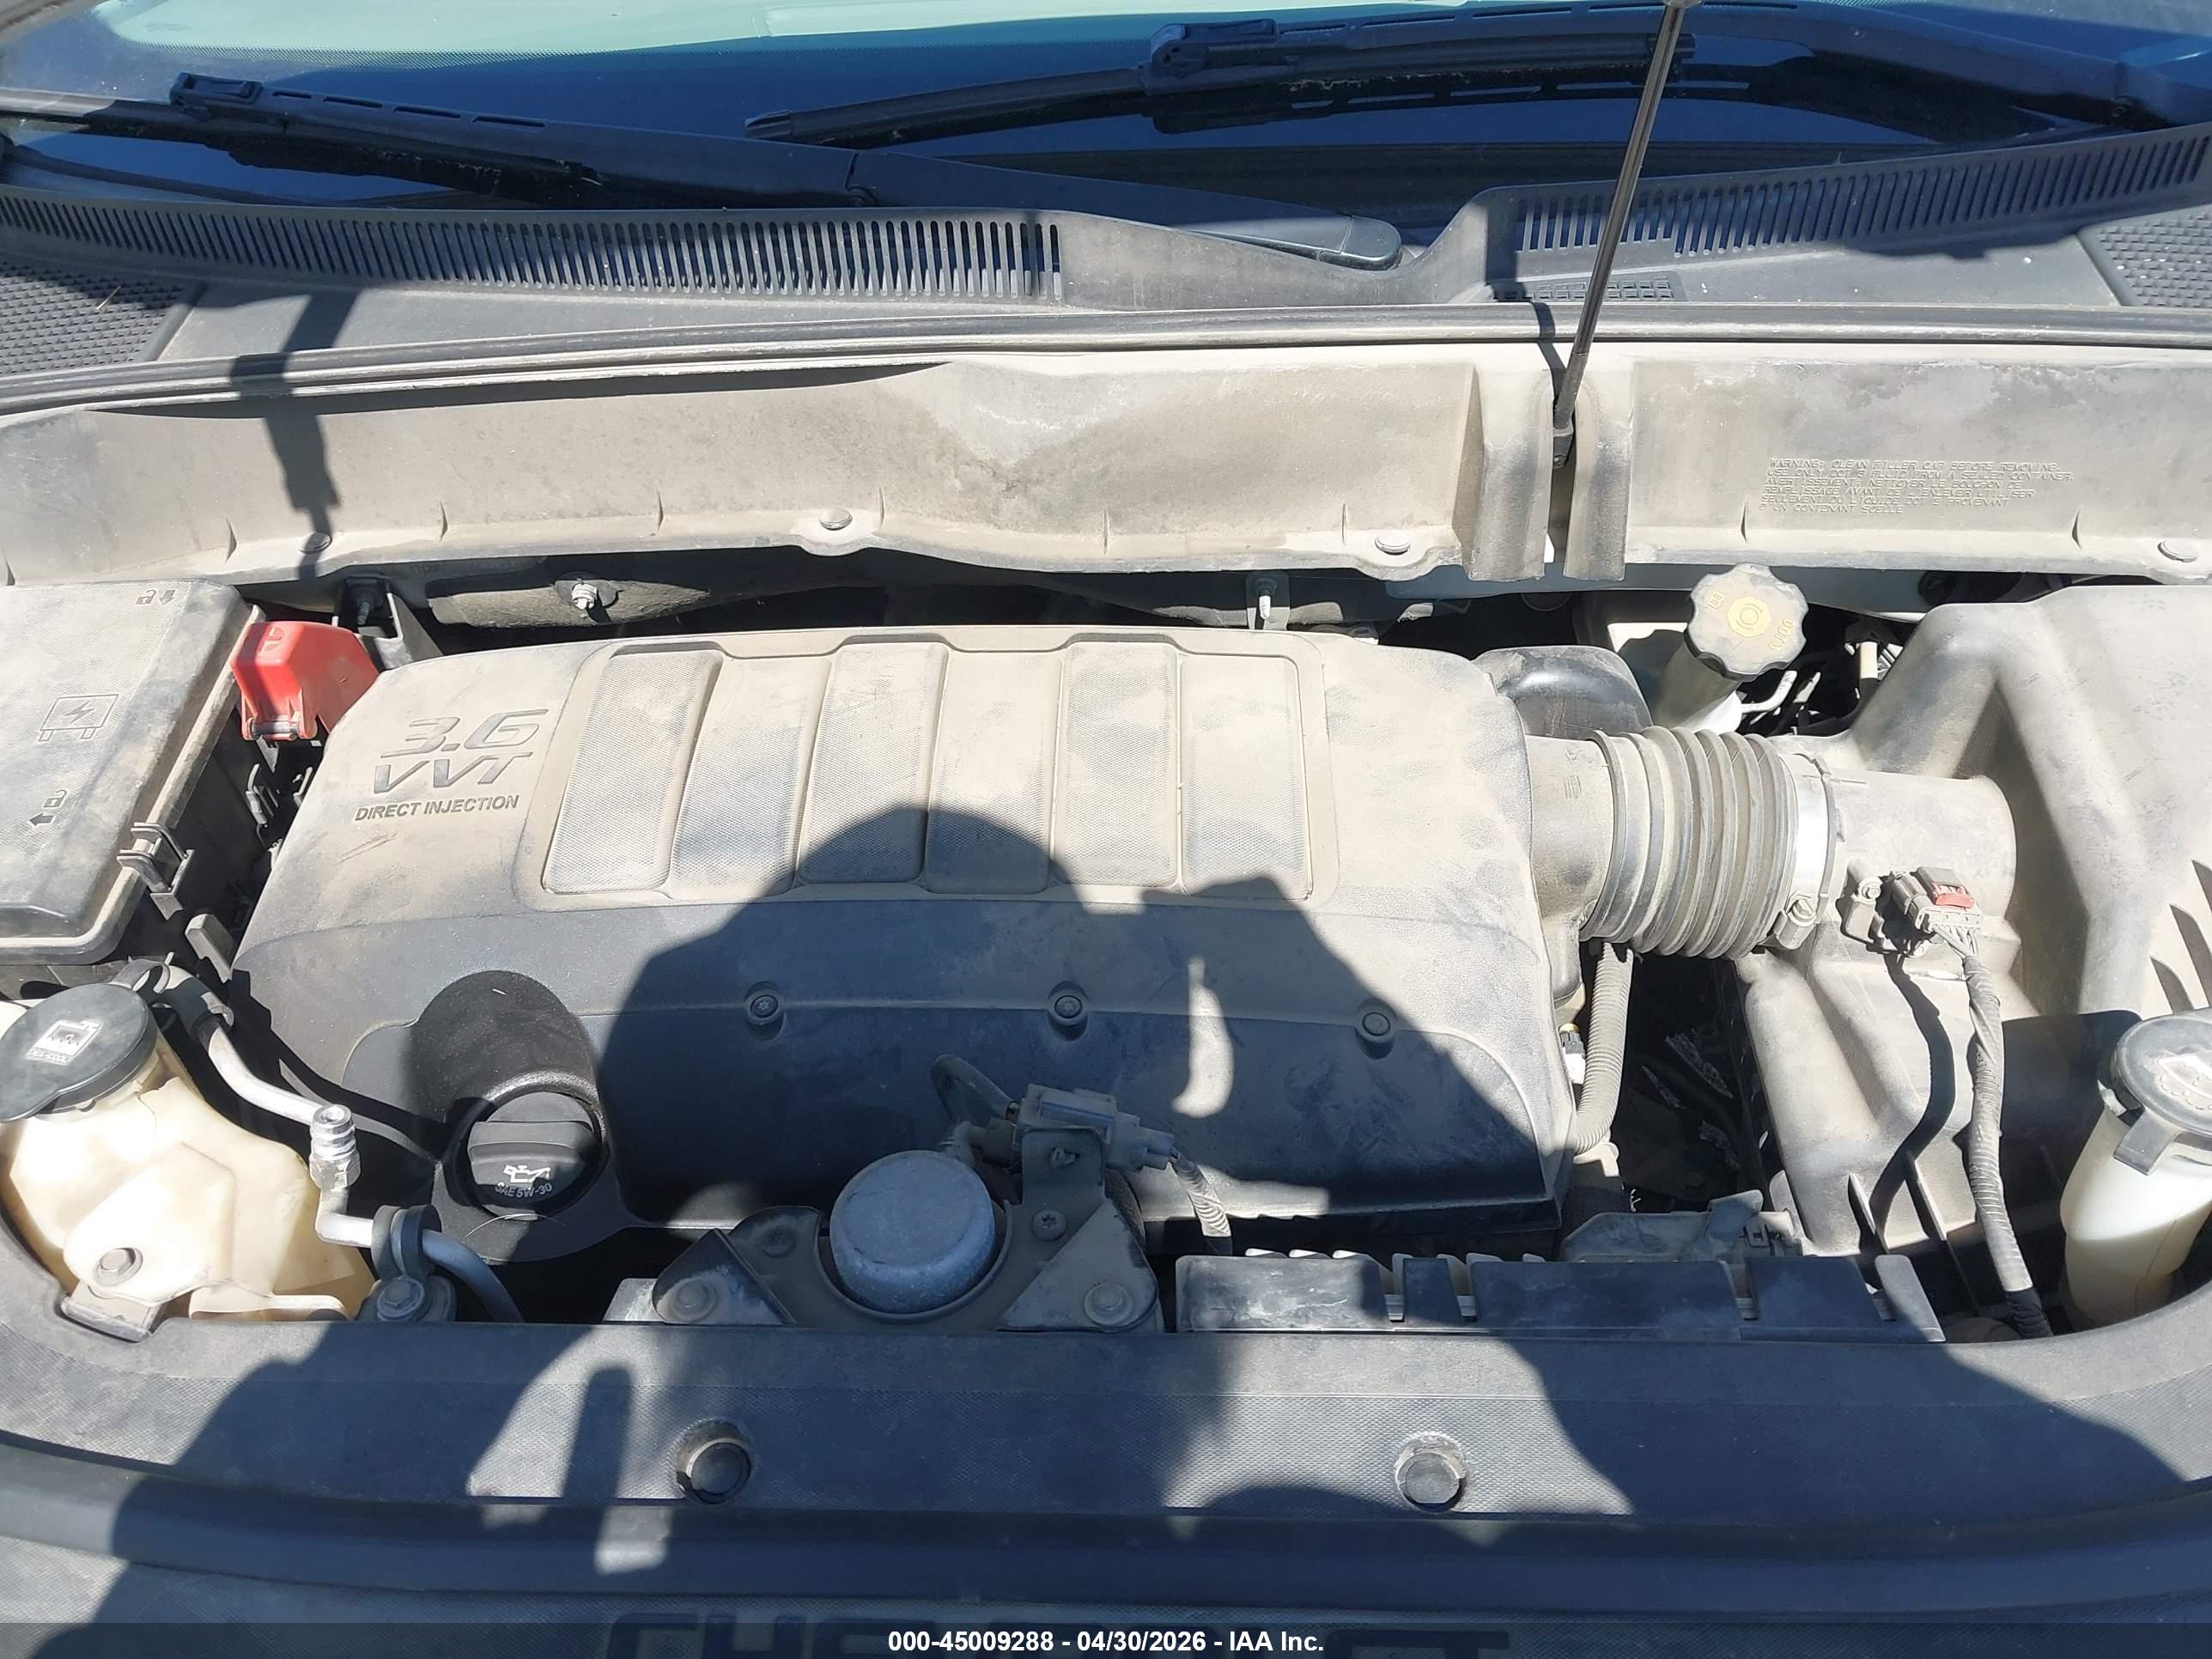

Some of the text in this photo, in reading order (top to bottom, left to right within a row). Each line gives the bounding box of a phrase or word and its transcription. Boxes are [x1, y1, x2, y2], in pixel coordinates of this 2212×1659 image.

[1766, 467, 1790, 477] USE
[1795, 468, 1825, 477] ONLY
[1914, 470, 1942, 478] FROM
[1947, 471, 1955, 479] A
[1961, 471, 2004, 480] SEALED
[1770, 458, 1825, 468] WARNING:
[1832, 459, 1869, 469] CLEAN
[1873, 460, 1917, 469] FILLER
[1923, 460, 1945, 470] CAP
[1951, 461, 1994, 470] BEFORE
[380, 708, 549, 758] 3.6
[374, 751, 533, 793] VVT
[355, 794, 520, 821] DIRECT INJECTION
[495, 1182, 553, 1198] SAE 5W-30
